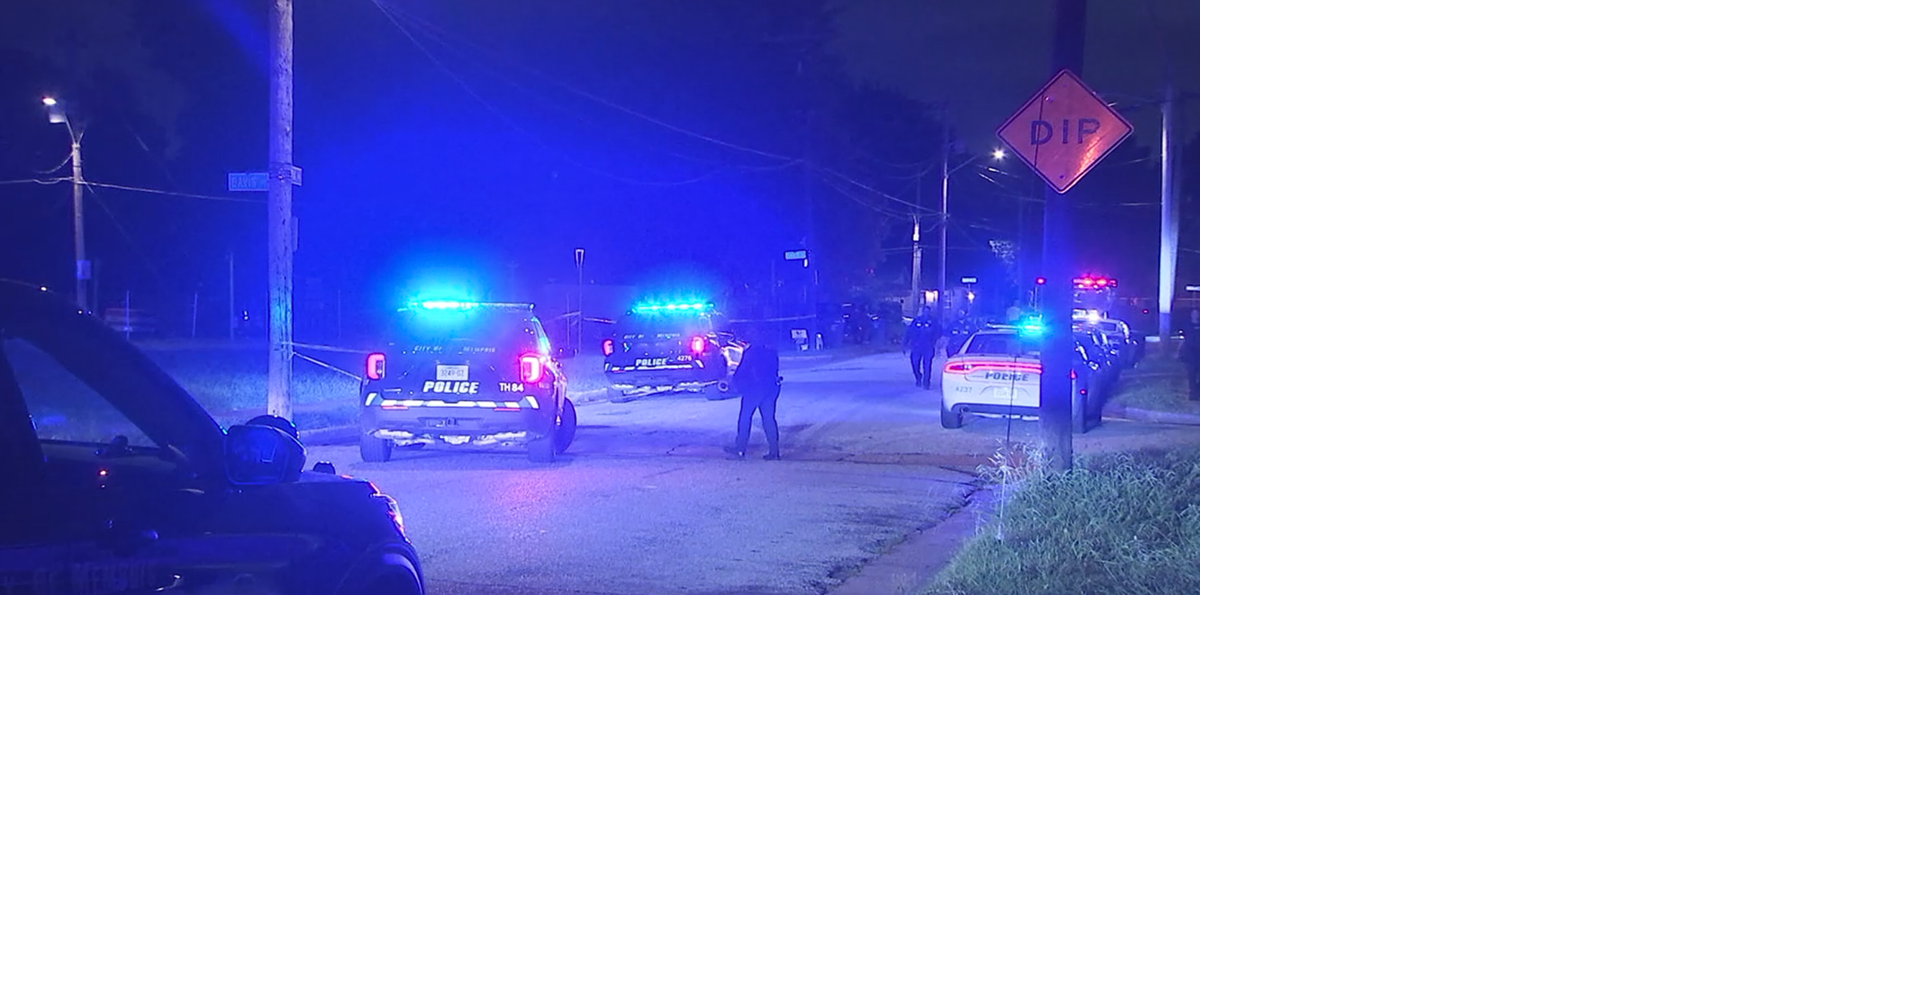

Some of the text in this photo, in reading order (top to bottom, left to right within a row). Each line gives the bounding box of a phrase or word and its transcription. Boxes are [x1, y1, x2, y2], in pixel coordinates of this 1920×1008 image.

[1031, 118, 1101, 145] DIP
[635, 358, 667, 366] POLICE
[985, 371, 1030, 381] POLICE
[423, 381, 479, 394] POLICE
